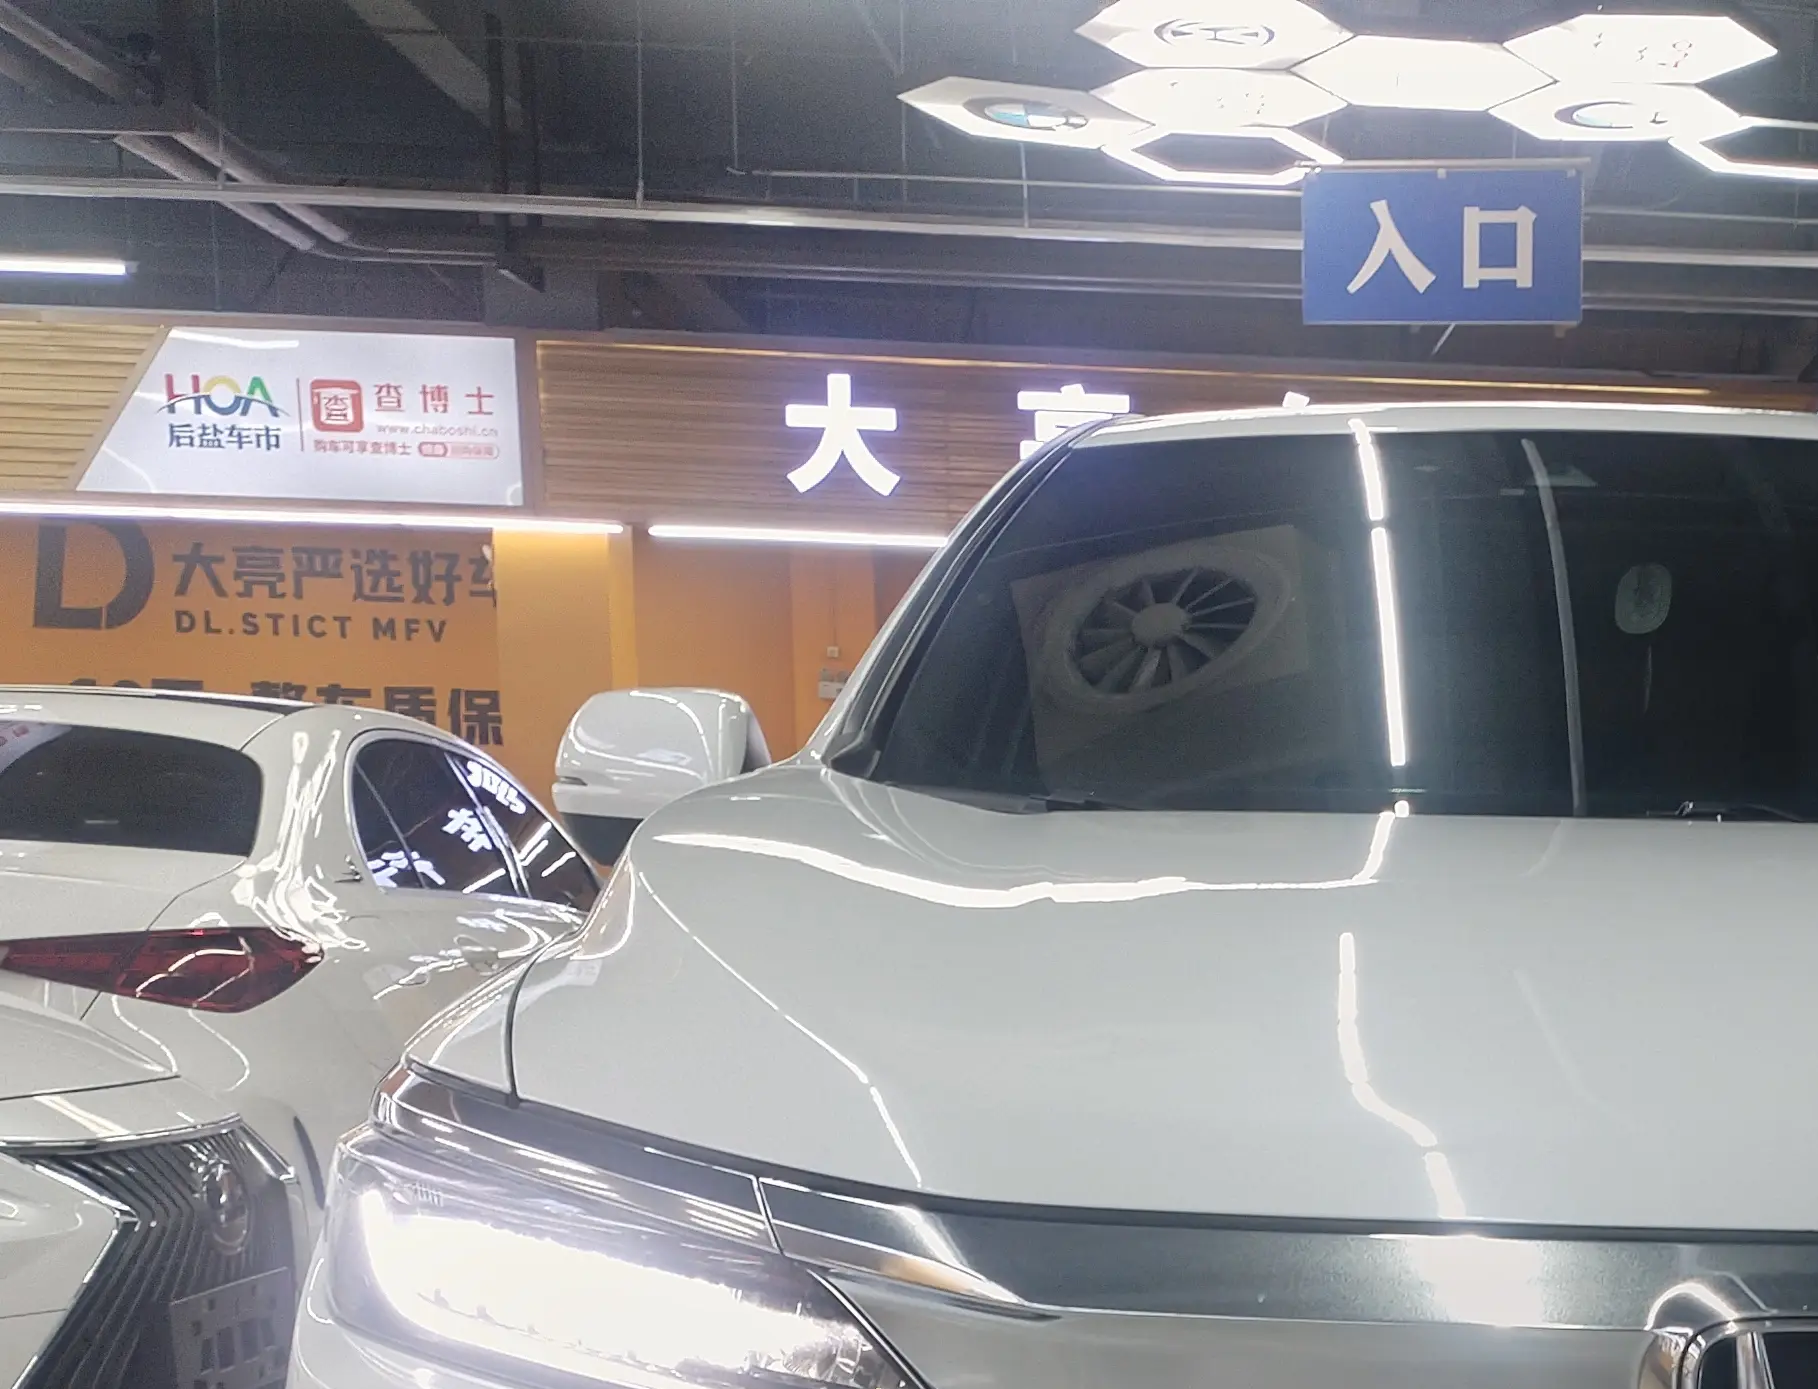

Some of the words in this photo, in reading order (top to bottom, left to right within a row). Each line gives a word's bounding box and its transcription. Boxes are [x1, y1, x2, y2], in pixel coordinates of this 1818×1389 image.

[1346, 198, 1537, 294] 入口
[160, 373, 285, 417] HOA
[373, 383, 495, 415] 查博士
[168, 422, 281, 451] 后盐车市
[376, 422, 499, 438] www.chaboshi.cn
[174, 609, 352, 639] DL.STICT
[372, 617, 448, 643] MFV
